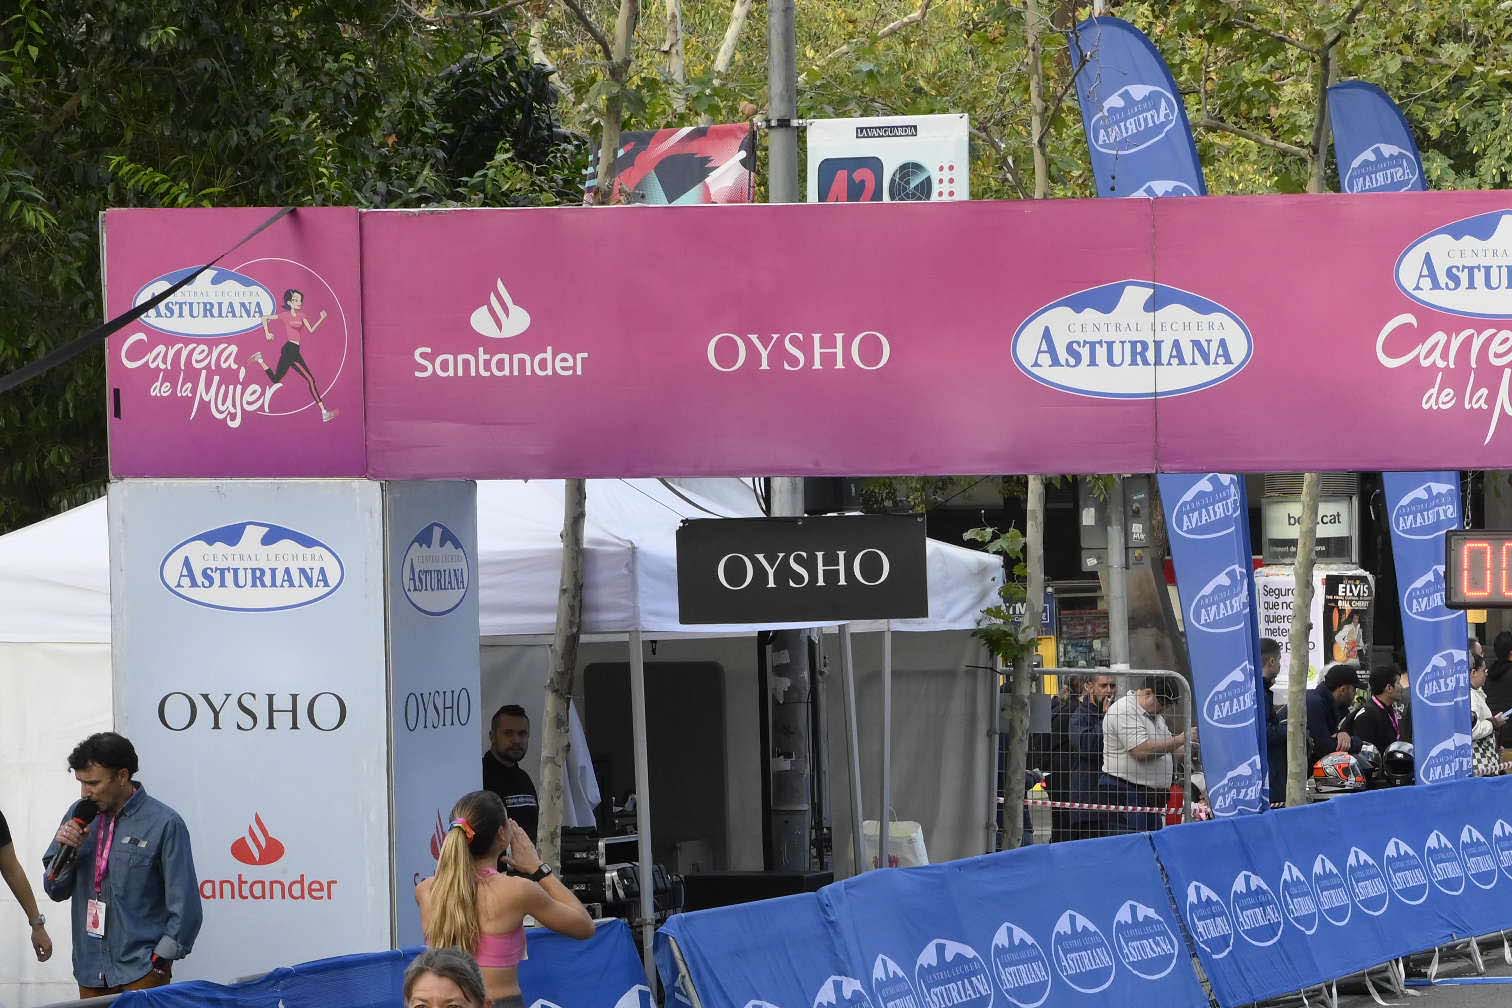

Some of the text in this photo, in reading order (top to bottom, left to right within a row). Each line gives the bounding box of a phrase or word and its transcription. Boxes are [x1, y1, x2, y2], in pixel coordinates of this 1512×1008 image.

[1067, 320, 1226, 334] CENTRAL LECHERA
[120, 332, 239, 370] Carrera
[413, 345, 589, 379] Santander
[706, 330, 891, 372] OYSHO
[1030, 325, 1235, 369] ASTURIANA
[150, 367, 284, 428] de la Mujer
[1421, 371, 1456, 410] de
[1464, 370, 1488, 410] la
[174, 555, 331, 589] ASTURIANA
[202, 552, 325, 562] CENTRAL LECHERA
[717, 547, 890, 591] OYSHO
[407, 567, 466, 592] ASTURIANA
[1338, 583, 1369, 597] ELVIS
[1263, 602, 1280, 612] que
[157, 690, 348, 732] OYSHO
[404, 686, 471, 733] OYSHO
[199, 873, 338, 901] antander
[997, 958, 1048, 990] ASTURIANA
[1057, 944, 1112, 976] ASTURIANA
